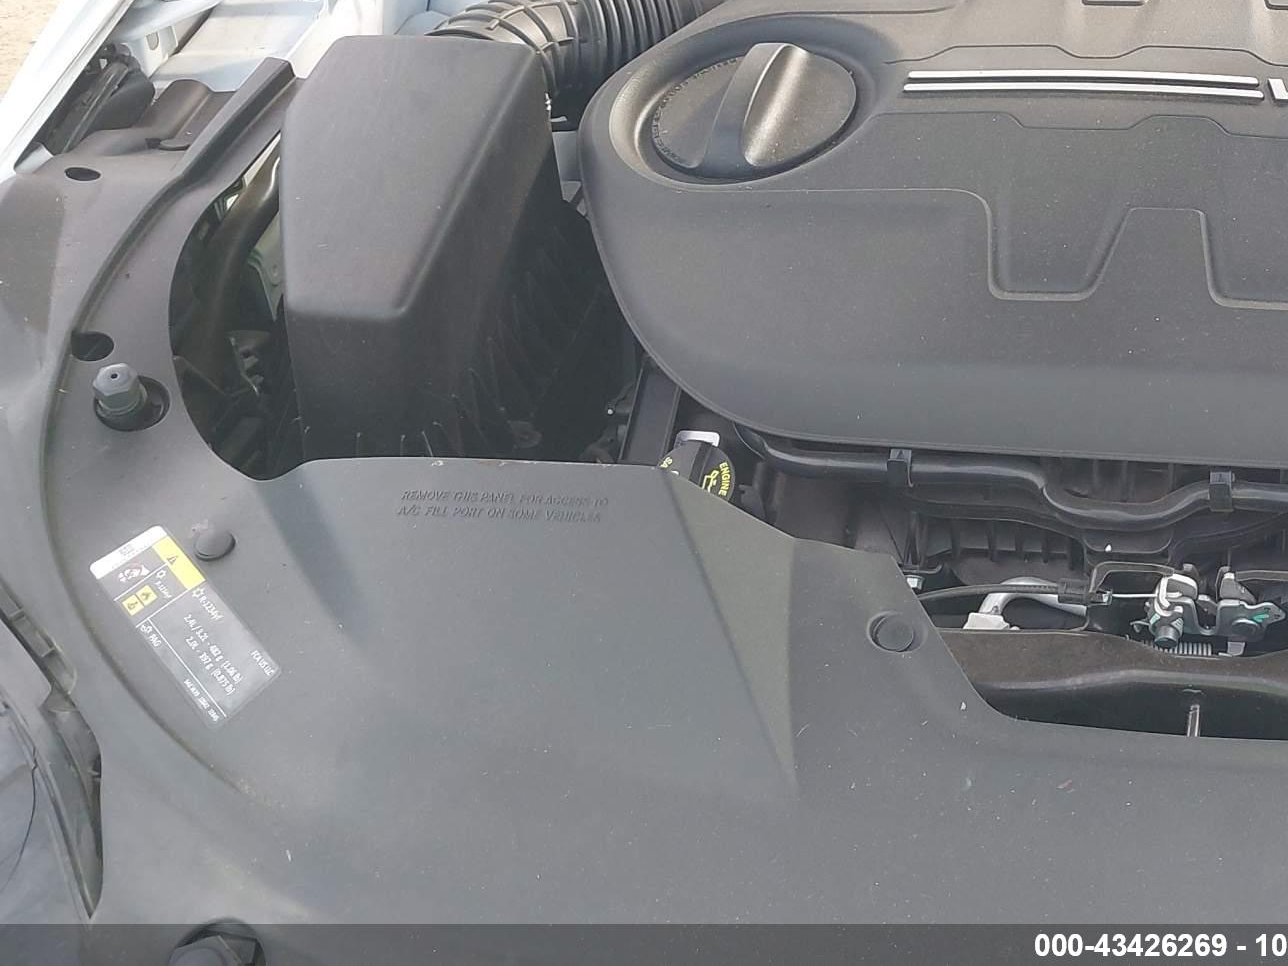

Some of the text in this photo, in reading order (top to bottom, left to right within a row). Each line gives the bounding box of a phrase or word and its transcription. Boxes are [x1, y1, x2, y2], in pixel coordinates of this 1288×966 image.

[718, 461, 732, 496] ENGINE
[400, 490, 450, 501] REMOVE
[453, 491, 478, 502] THIS
[480, 491, 515, 503] PANEL
[520, 493, 542, 504] FOR
[593, 497, 609, 507] TO
[397, 504, 601, 522] A/C FILL PORT ON SOME VEHICLES
